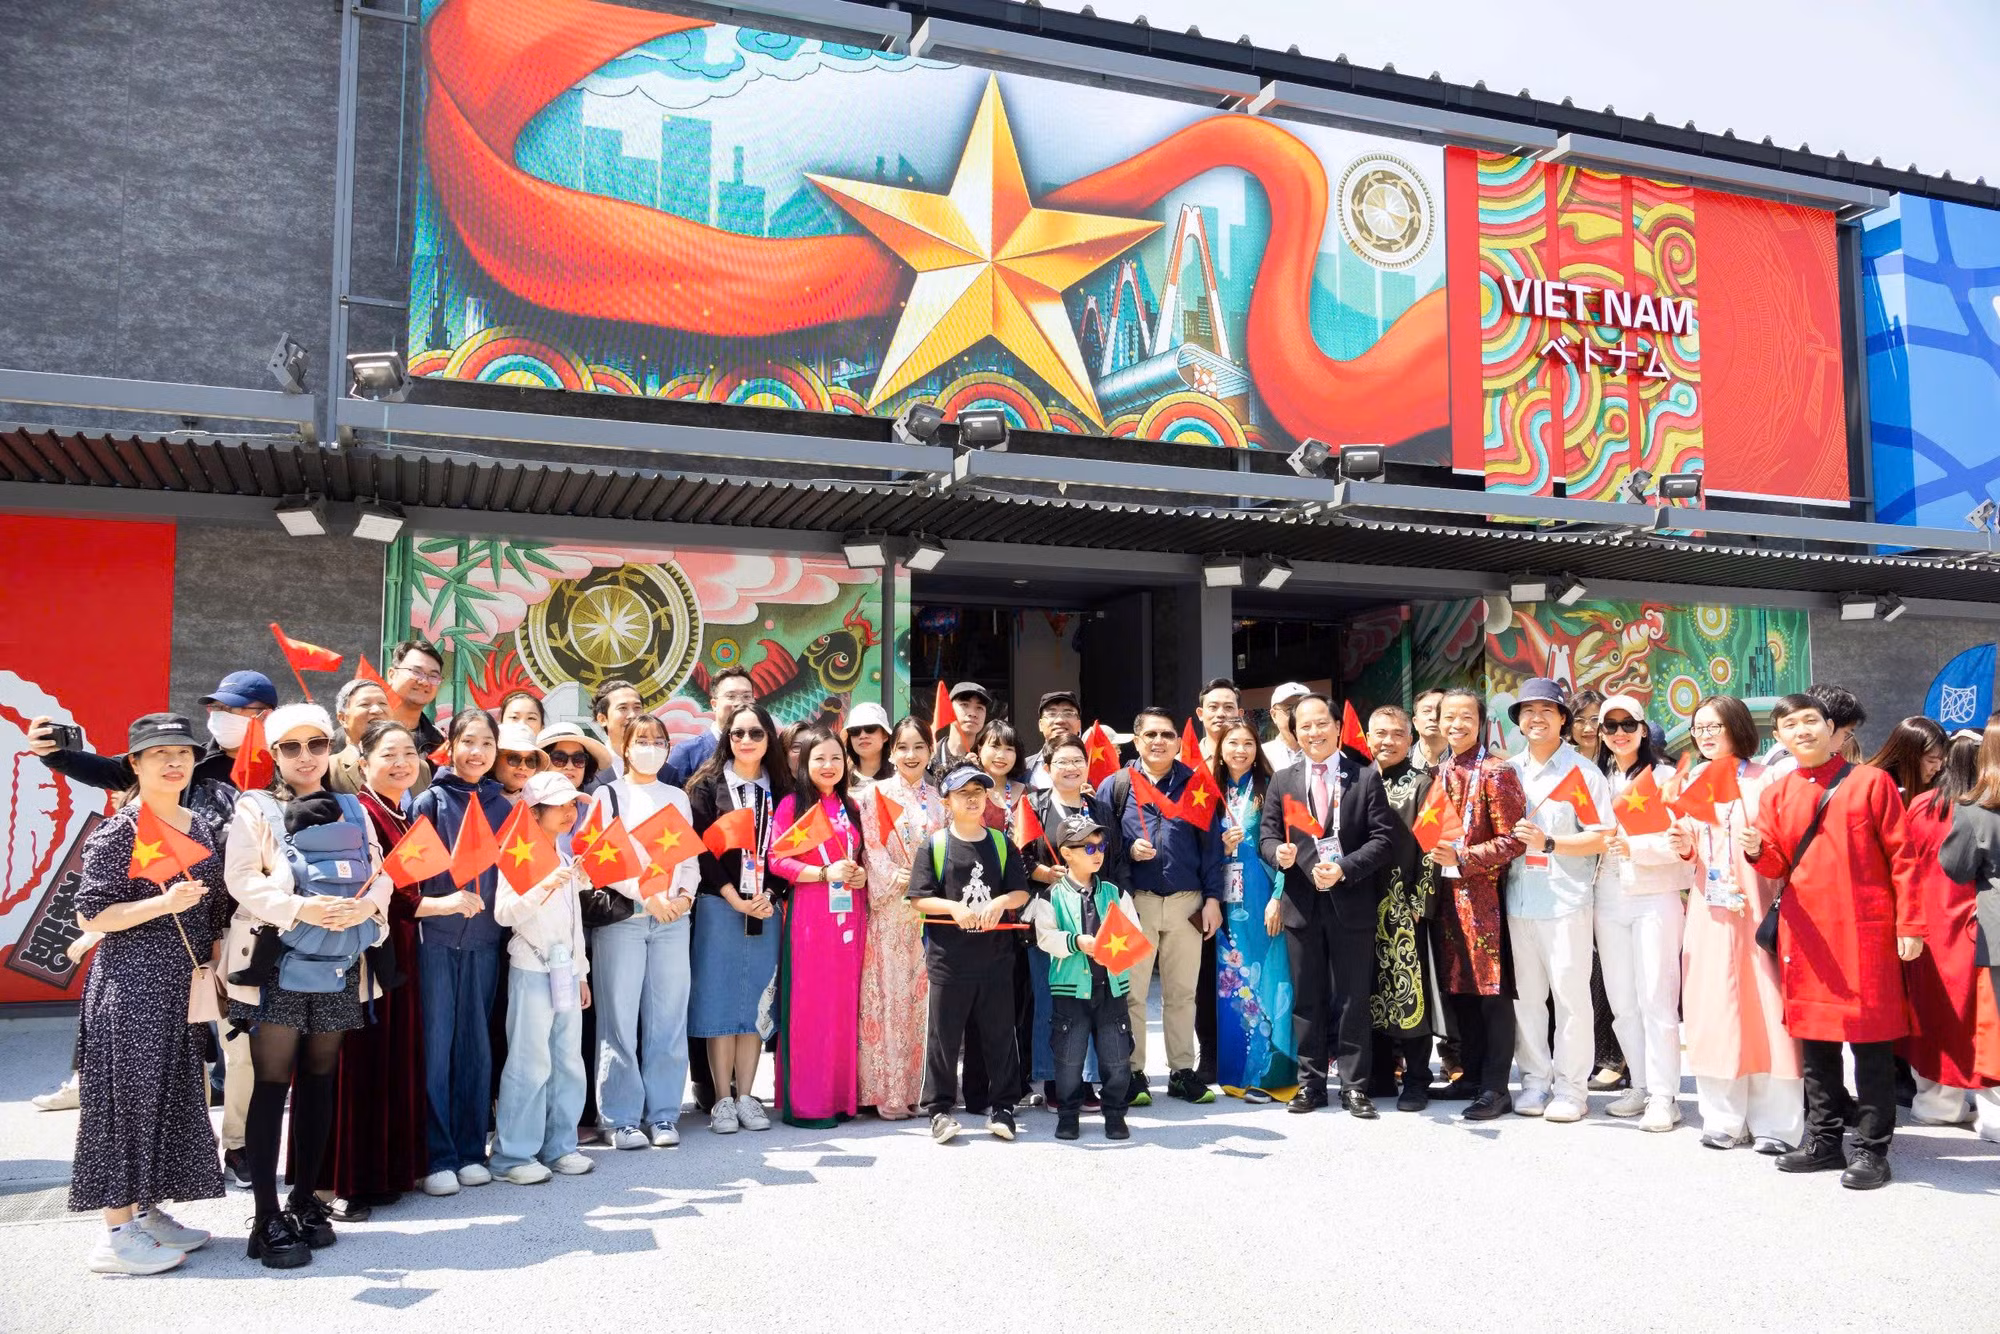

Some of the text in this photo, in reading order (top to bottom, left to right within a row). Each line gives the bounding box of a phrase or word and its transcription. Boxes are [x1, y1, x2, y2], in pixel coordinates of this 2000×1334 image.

[1503, 275, 1693, 335] VIET NAM
[1540, 336, 1671, 380] ベトナム
